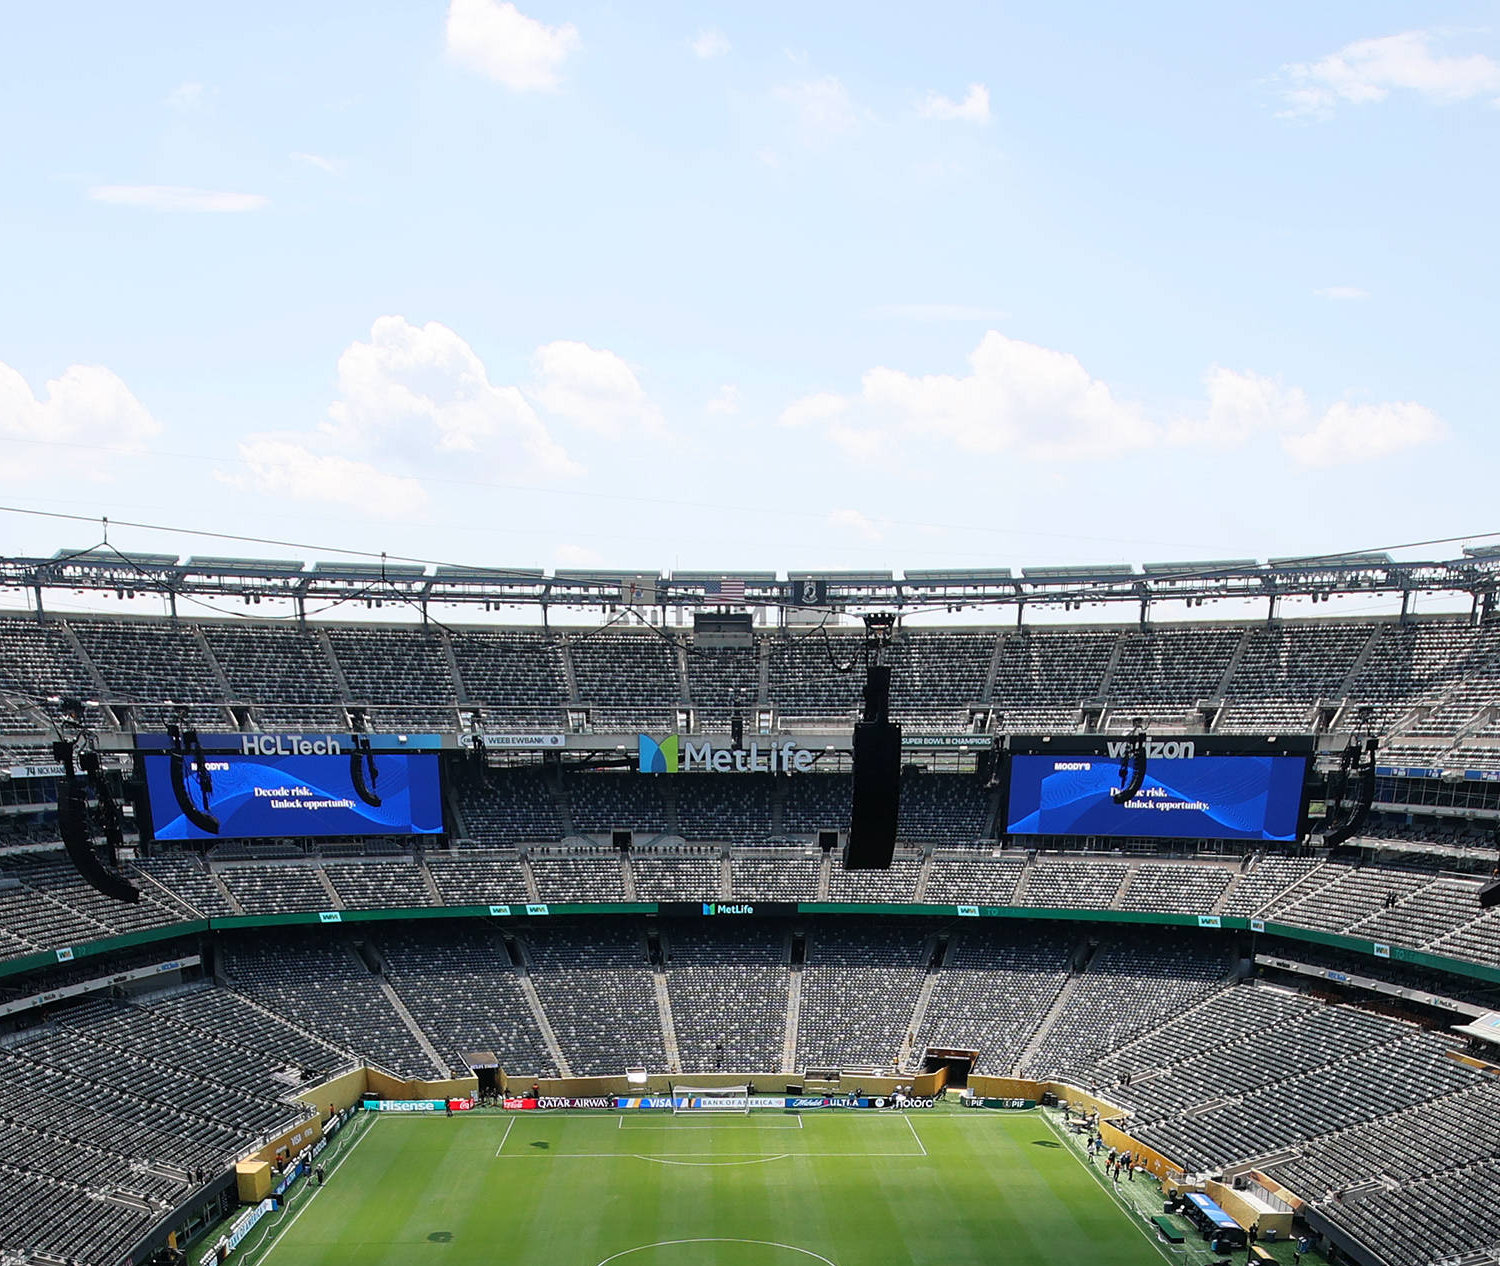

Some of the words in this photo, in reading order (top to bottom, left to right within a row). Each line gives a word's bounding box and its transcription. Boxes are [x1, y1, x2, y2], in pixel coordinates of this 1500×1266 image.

[241, 735, 341, 755] HCLTech
[511, 736, 544, 745] EWBANK
[901, 737, 921, 746] SUPER
[922, 737, 944, 746] BOWL
[951, 736, 991, 746] CHAMPIONS
[1106, 738, 1195, 759] veizon
[685, 740, 813, 771] MetLife
[191, 762, 229, 771] MODY'S
[254, 787, 289, 797] Decode
[290, 786, 313, 797] risk.
[1146, 787, 1168, 797] risk.
[271, 799, 302, 808] Unlock
[303, 799, 356, 810] opportunity.
[1155, 801, 1209, 811] opportunity.
[717, 904, 754, 914] MetLife
[379, 1100, 434, 1111] Hisense
[538, 1098, 570, 1109] QATAR
[649, 1099, 673, 1108] VISA
[971, 1099, 984, 1107] PIF
[1012, 1100, 1025, 1108] PIF
